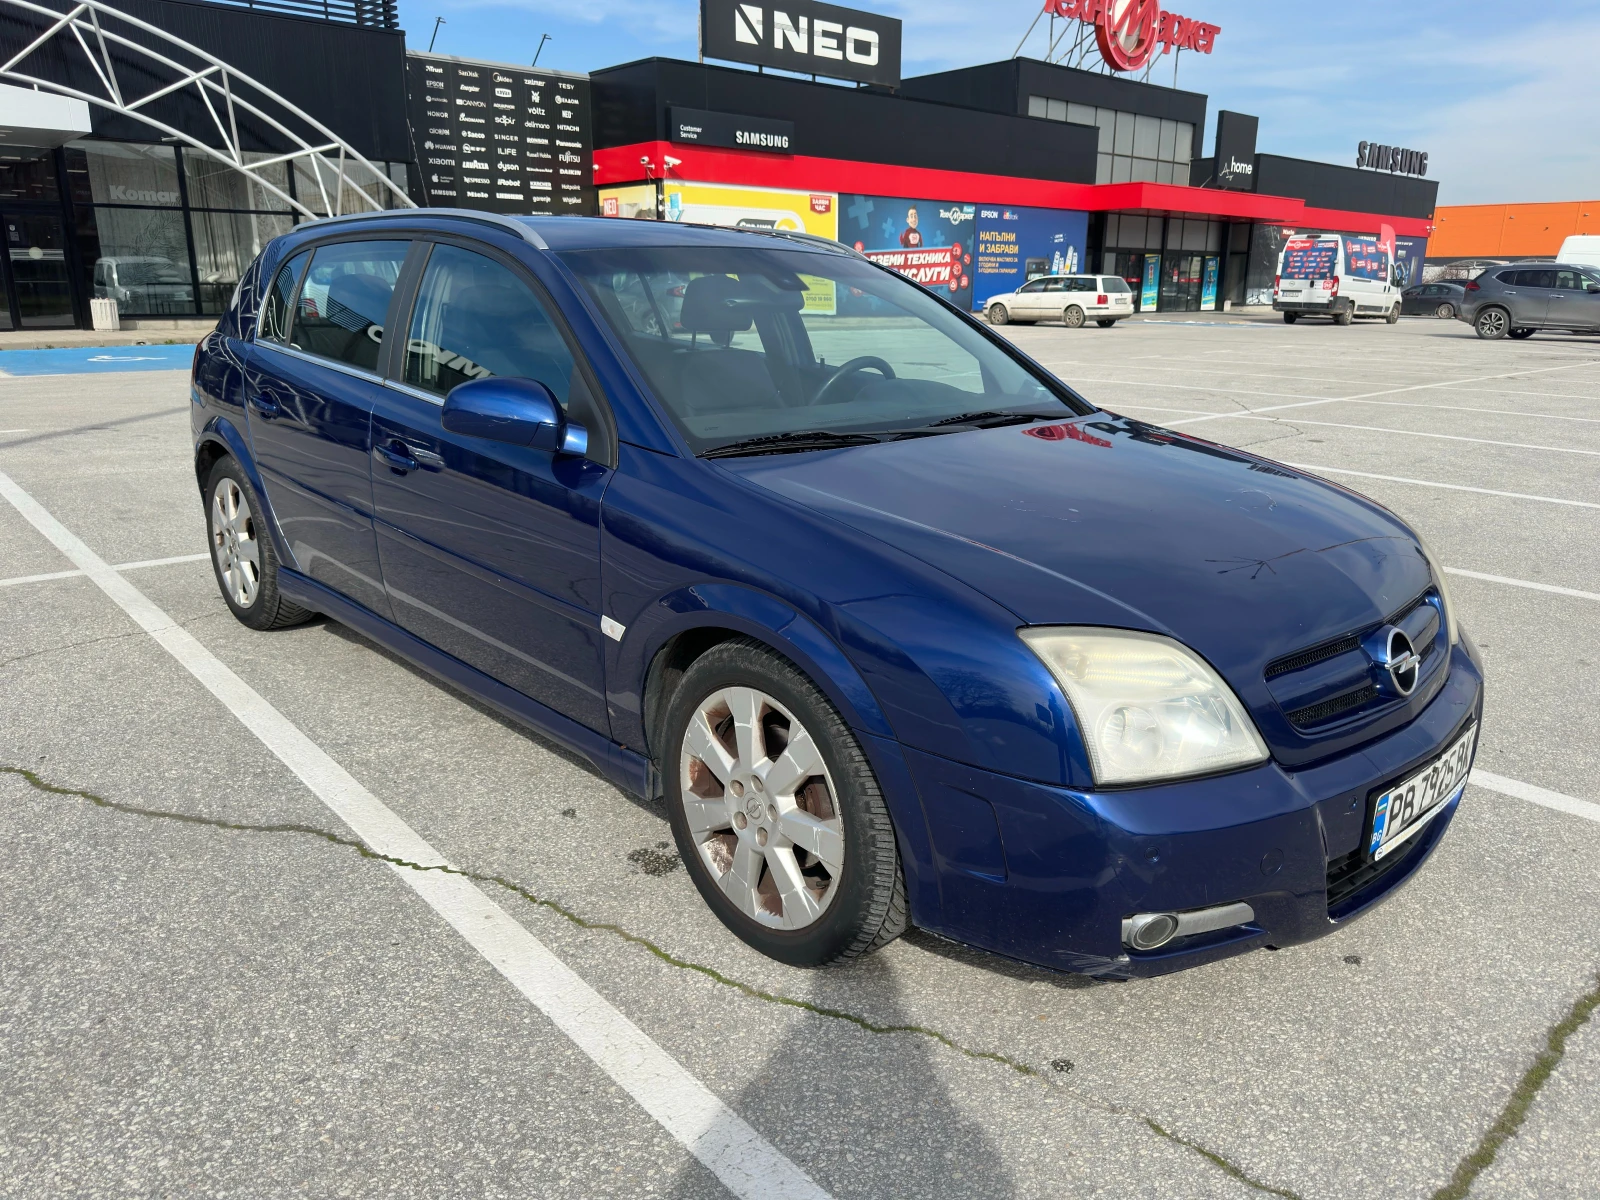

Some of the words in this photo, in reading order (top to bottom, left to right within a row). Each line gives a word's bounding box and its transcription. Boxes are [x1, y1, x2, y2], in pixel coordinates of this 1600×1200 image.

[773, 10, 879, 66] NEO
[429, 65, 443, 73] Trust
[458, 69, 479, 78] SanDisk
[426, 80, 444, 88] EPSON
[558, 82, 575, 90] TESY
[462, 100, 486, 108] CANYON
[427, 110, 448, 118] HONOR
[557, 124, 580, 132] HITACHI
[680, 124, 702, 133] Customer
[467, 131, 485, 139] Saeco
[736, 131, 789, 148] SAMSUNG
[556, 139, 582, 148] Panasonic
[559, 153, 580, 163] FUJITSU
[1356, 140, 1429, 177] SAMSUNG
[497, 161, 519, 171] dyson
[1231, 155, 1253, 175] home
[559, 168, 581, 176] DAIKIN
[109, 185, 180, 202] Komar
[603, 200, 616, 215] NEO
[981, 210, 998, 219] EPSON
[980, 231, 1016, 242] НАПЪЛНИ
[979, 244, 985, 253] И
[986, 244, 1019, 254] ЗАБРАВИ
[907, 252, 951, 265] ТЕХНИКА
[1385, 784, 1415, 837] PB
[1420, 750, 1457, 811] 7925
[1372, 830, 1382, 844] BG
